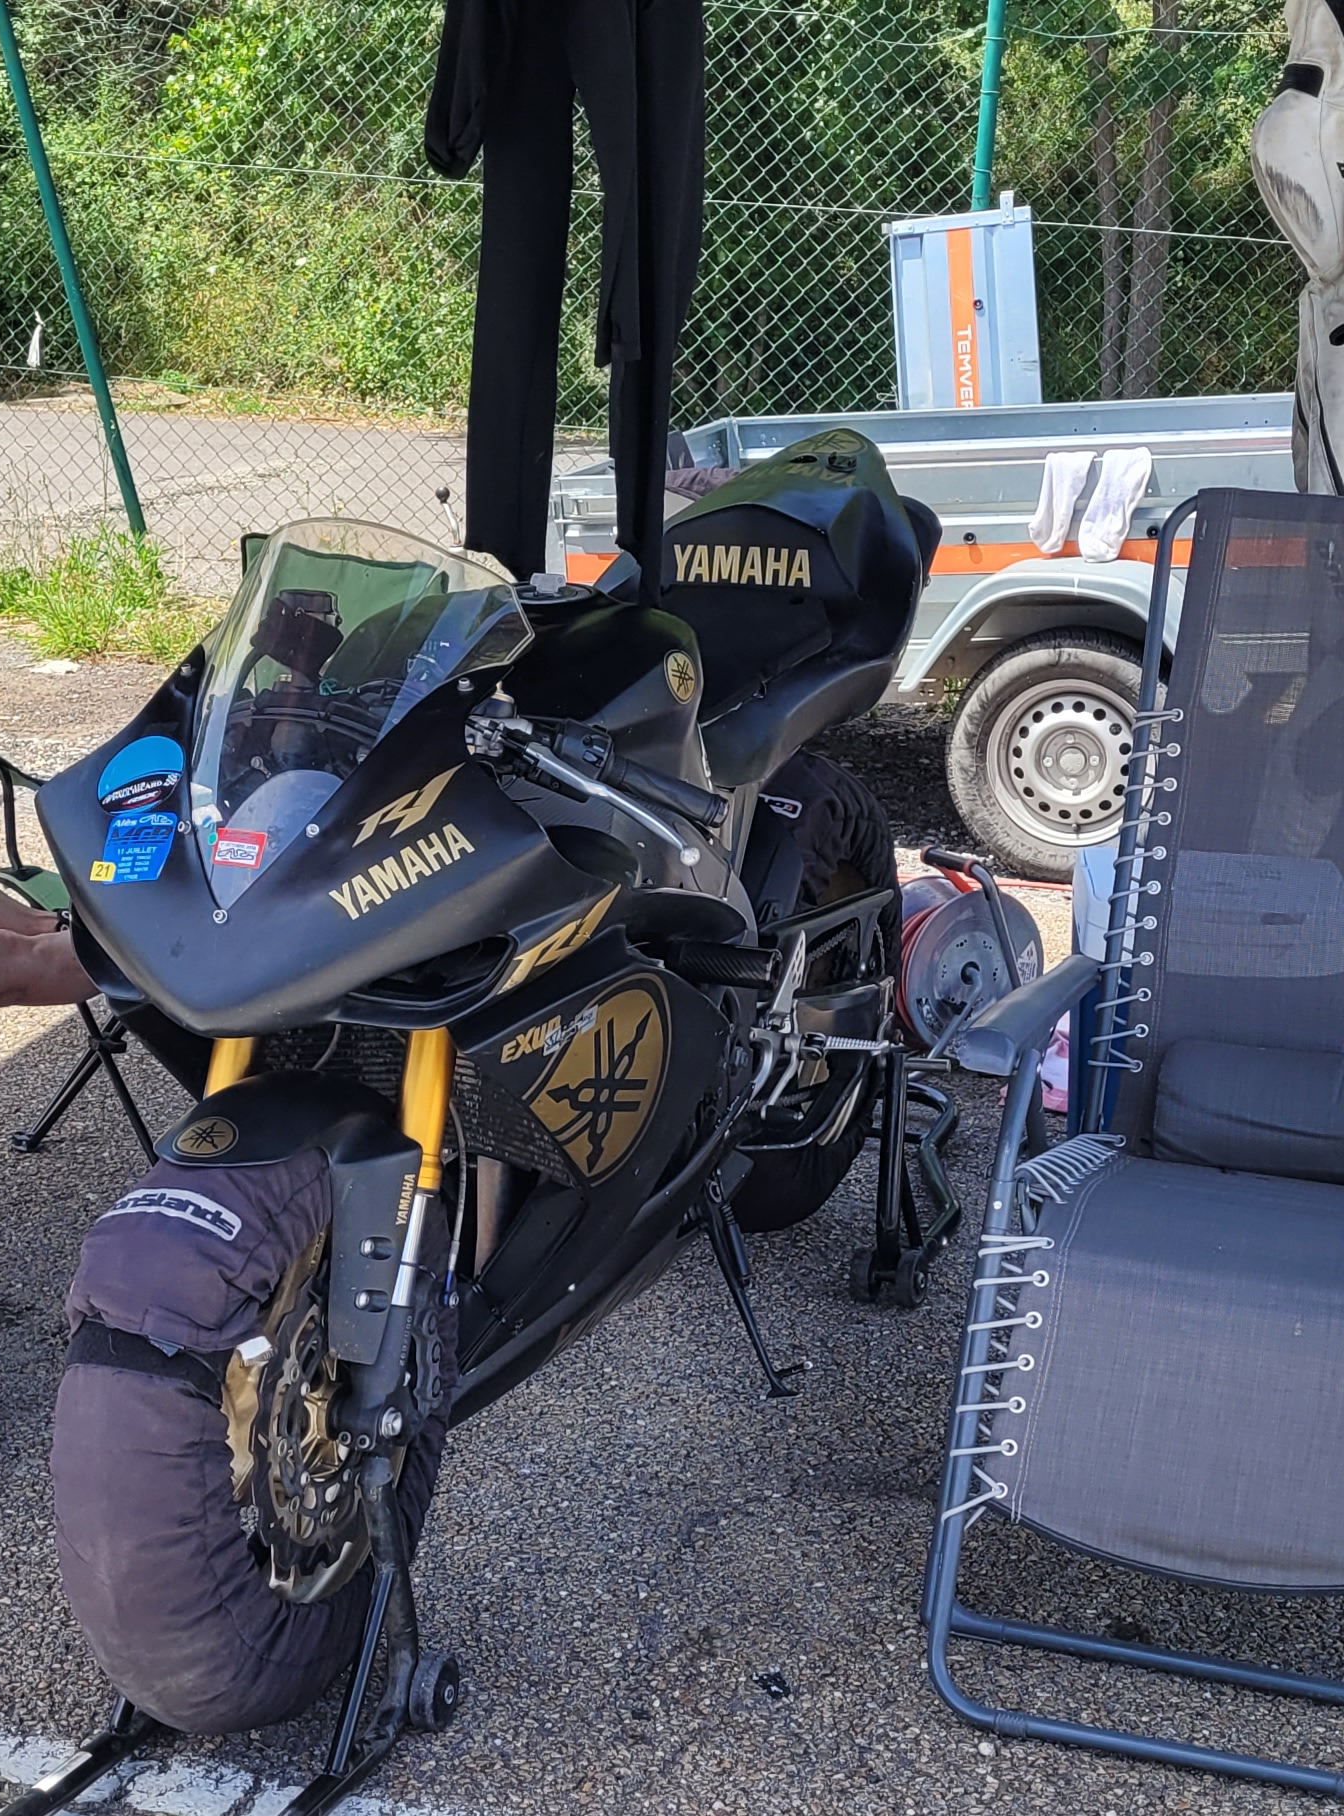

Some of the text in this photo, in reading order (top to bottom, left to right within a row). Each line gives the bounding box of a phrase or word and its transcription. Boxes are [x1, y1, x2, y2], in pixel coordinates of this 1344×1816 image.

[674, 544, 811, 588] YAMAHA
[95, 864, 110, 878] 21
[328, 823, 475, 920] YAMAHA
[396, 1173, 416, 1226] YAMAHA
